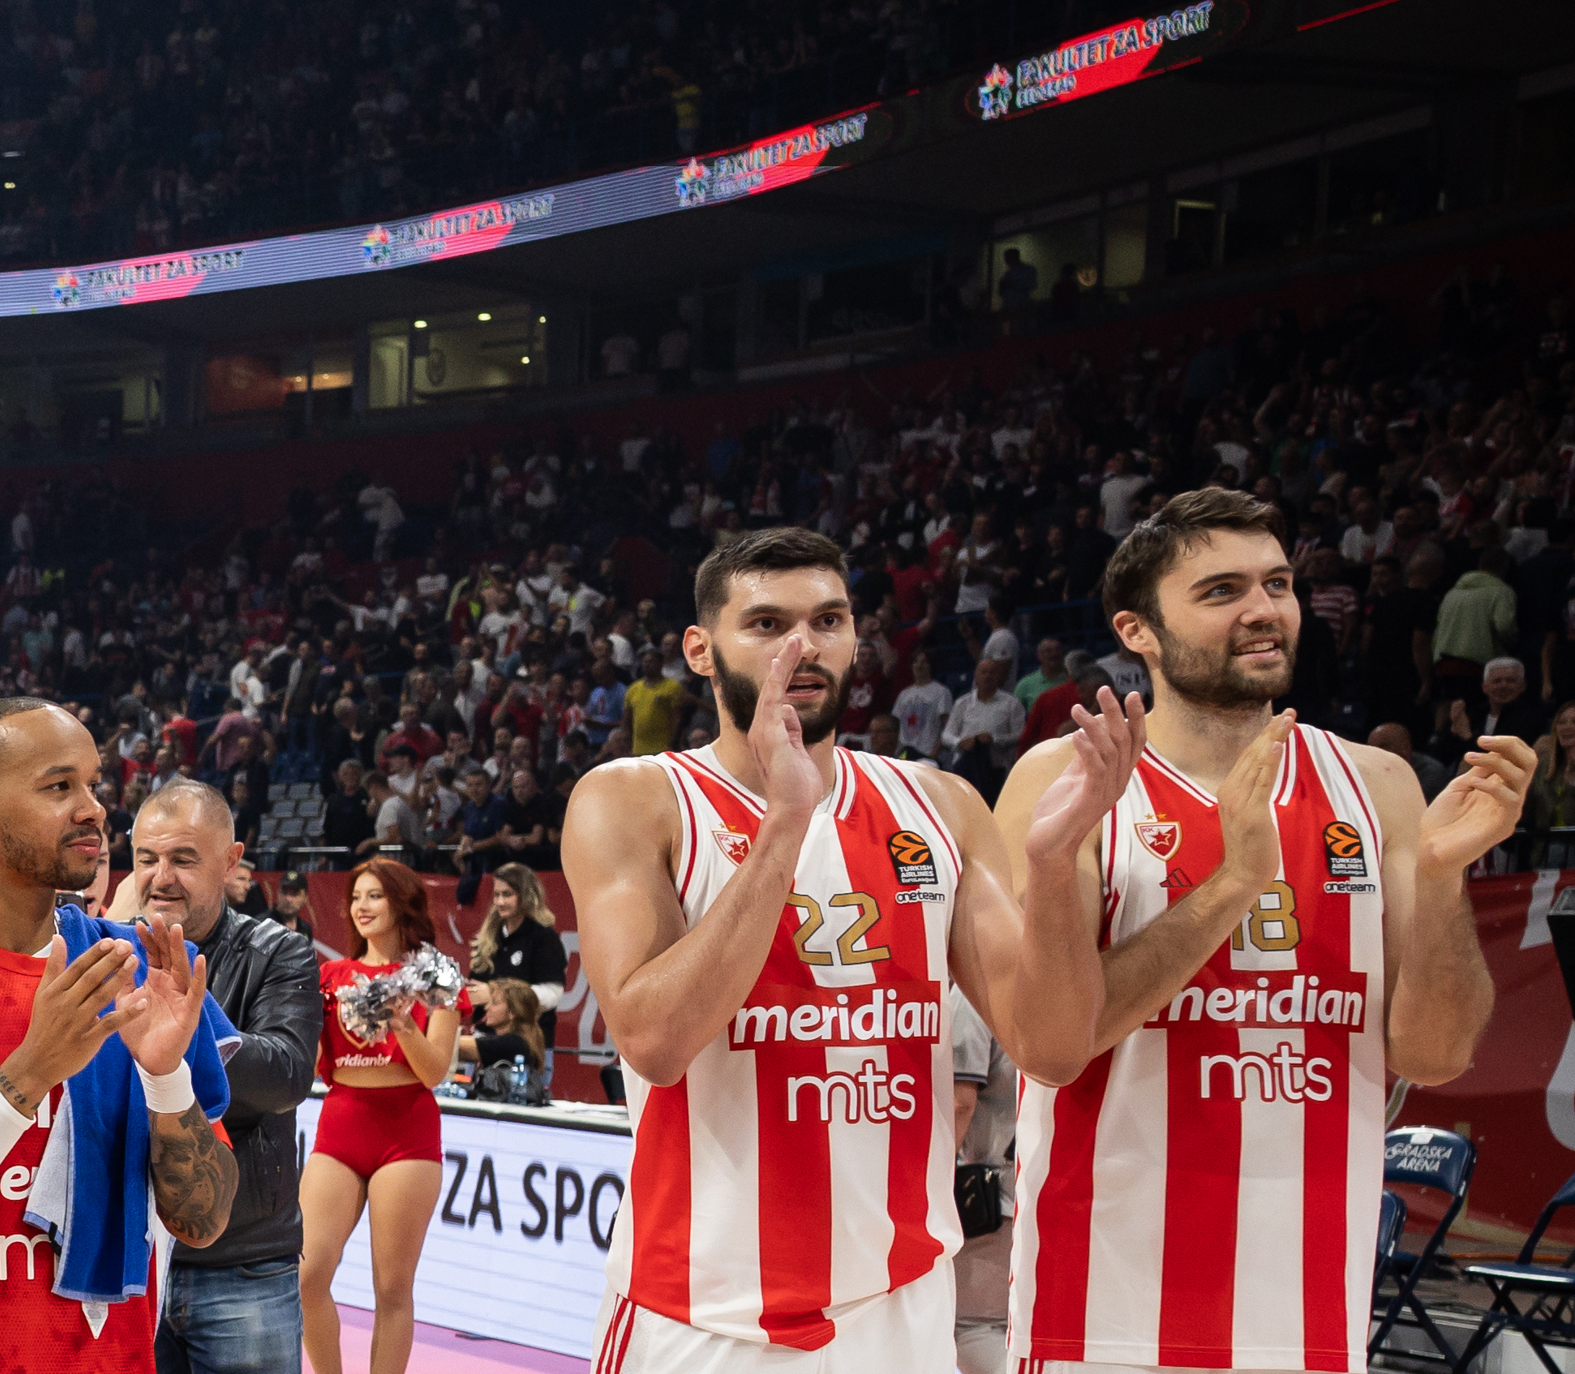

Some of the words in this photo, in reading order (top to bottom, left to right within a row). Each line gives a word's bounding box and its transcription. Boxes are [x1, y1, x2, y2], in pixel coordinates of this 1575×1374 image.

[896, 890, 946, 902] oneteam
[1325, 882, 1376, 892] oneteam
[785, 891, 891, 966] 22
[1232, 880, 1300, 951] 8
[733, 988, 939, 1043] meridian
[787, 1063, 916, 1122] mts
[1201, 1045, 1332, 1101] mts
[1397, 1157, 1441, 1172] ARENA
[441, 1150, 502, 1234] ZA
[520, 1161, 625, 1251] SPO
